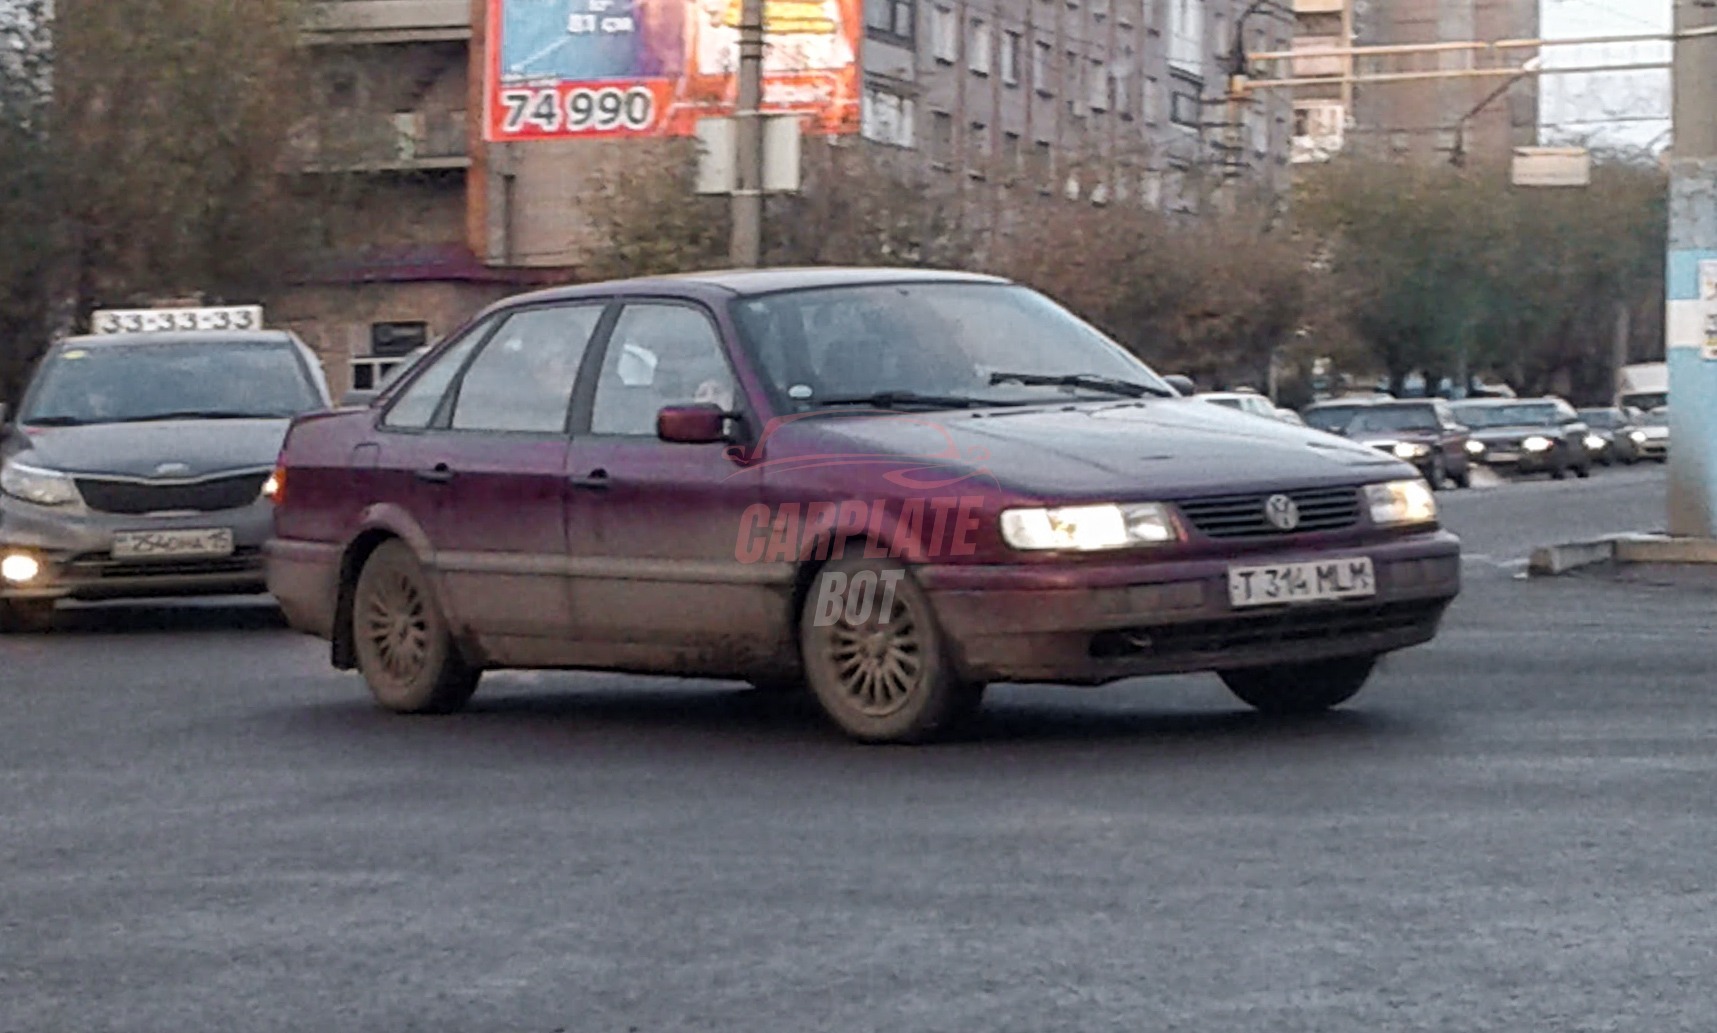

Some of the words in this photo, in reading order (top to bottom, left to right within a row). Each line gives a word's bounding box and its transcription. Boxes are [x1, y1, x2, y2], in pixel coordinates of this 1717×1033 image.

[504, 89, 560, 131] 74
[568, 87, 654, 131] 990
[100, 310, 253, 334] 33-33-33
[1238, 570, 1256, 600] T
[1264, 567, 1310, 598] 314
